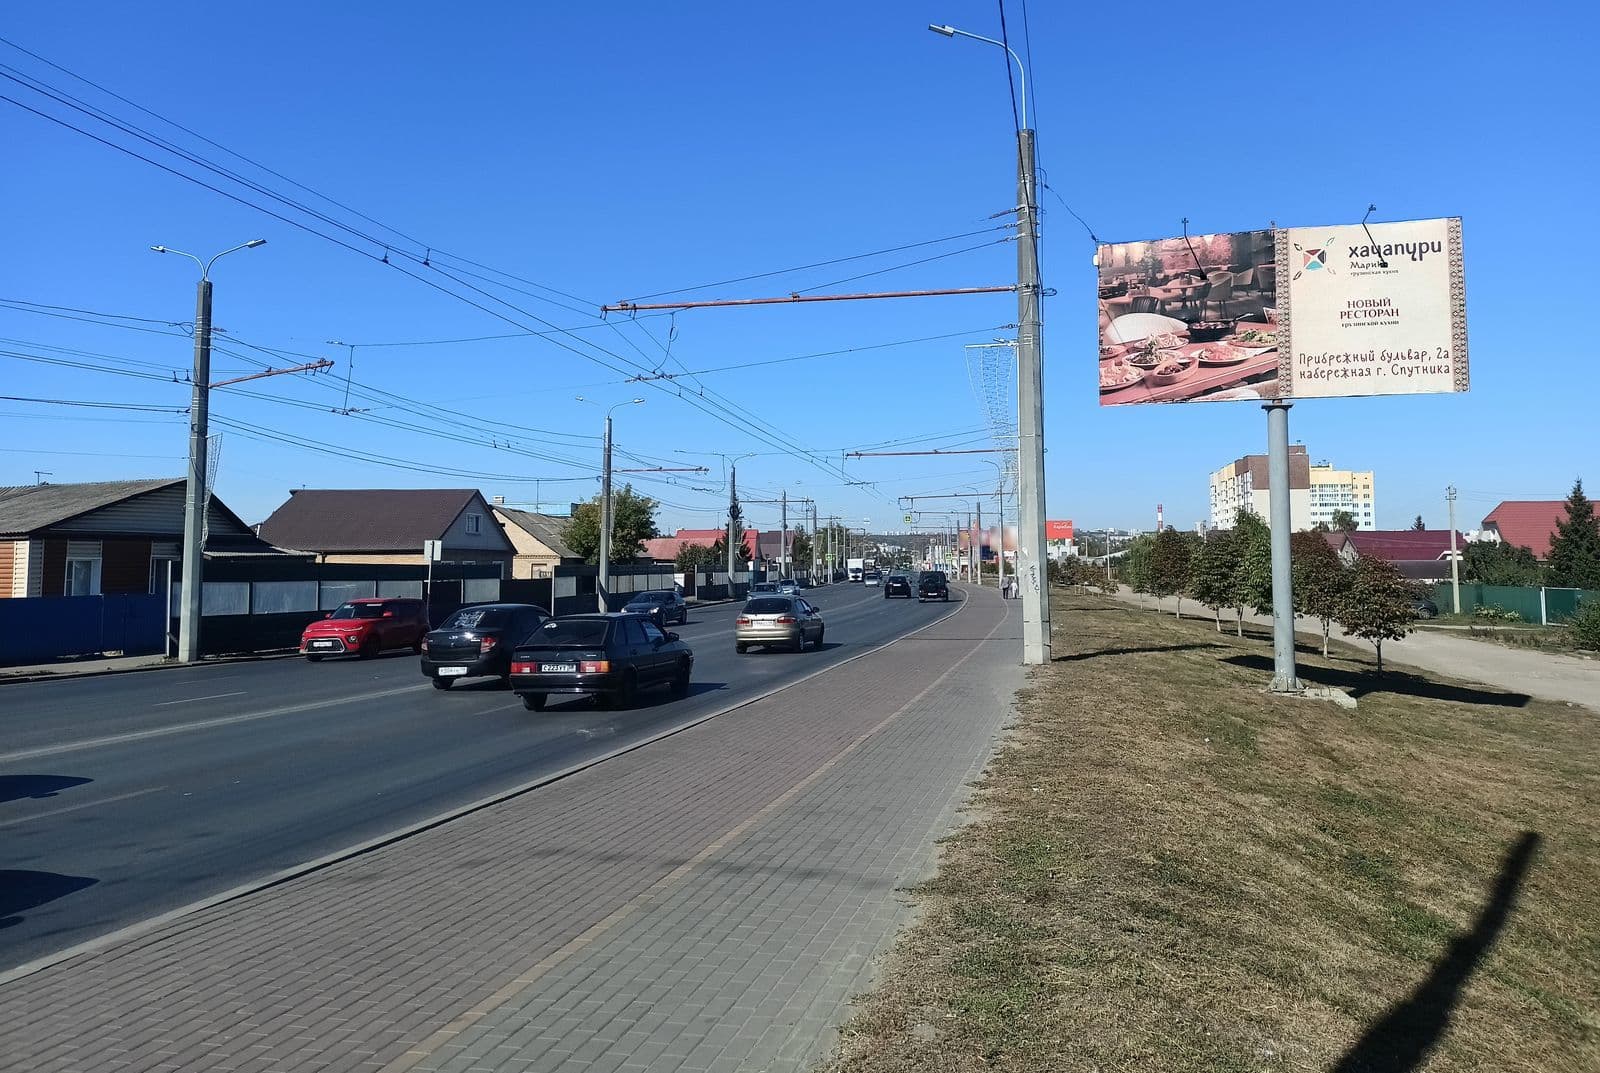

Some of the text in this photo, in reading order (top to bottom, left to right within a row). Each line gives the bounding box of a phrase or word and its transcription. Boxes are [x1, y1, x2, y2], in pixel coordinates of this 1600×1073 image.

[1349, 240, 1442, 261] хачапури
[1350, 261, 1388, 270] Марик
[1347, 297, 1391, 309] НОВЫЙ
[1340, 308, 1399, 320] РЕСТОРАН
[1299, 347, 1450, 367] Прибрежный бульвар, 2а
[1300, 364, 1450, 381] набережная г. Спутника
